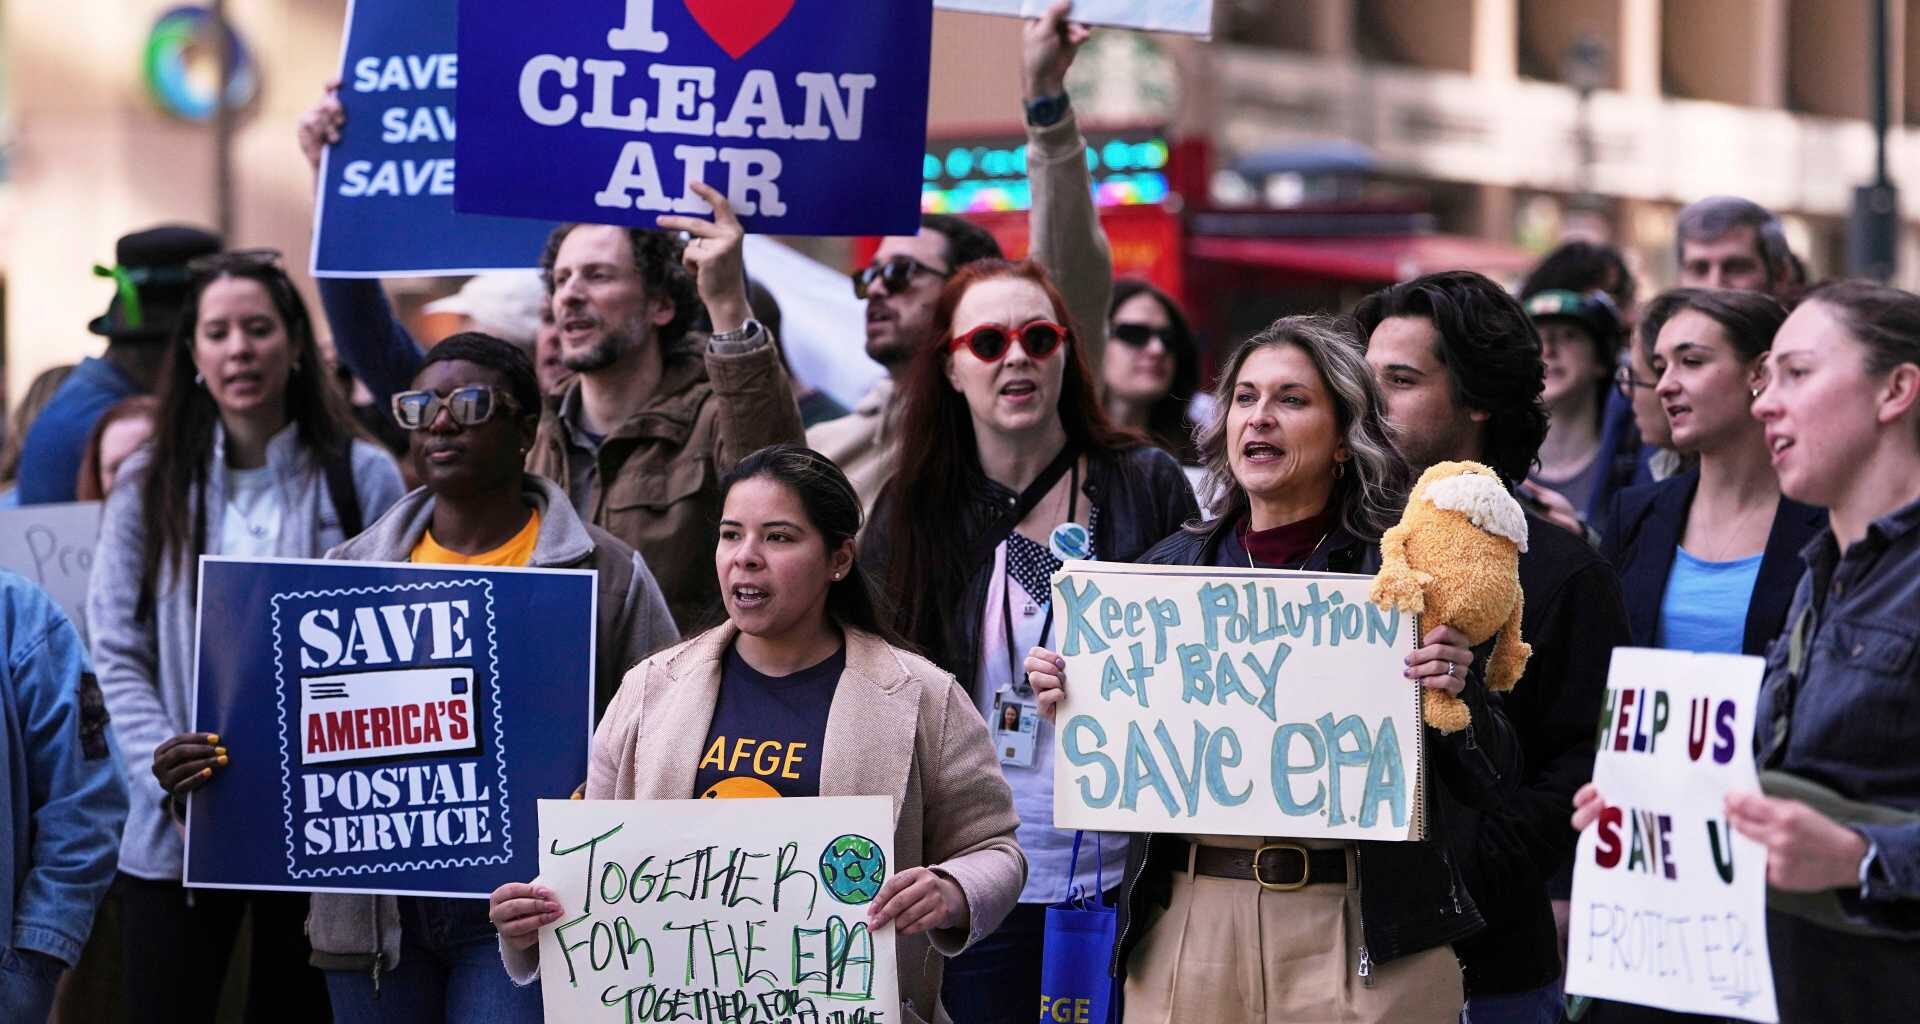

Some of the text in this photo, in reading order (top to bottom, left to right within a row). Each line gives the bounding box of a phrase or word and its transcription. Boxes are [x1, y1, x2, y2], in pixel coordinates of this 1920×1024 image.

[607, 0, 669, 53] I
[353, 54, 458, 92] SAVE
[519, 53, 877, 141] CLEAN
[338, 158, 456, 197] SAVE
[594, 141, 787, 217] AIR
[299, 600, 473, 669] SAVE
[1054, 575, 1181, 664] Keep
[1176, 641, 1292, 722] BAY
[307, 699, 470, 754] AMERICA'S
[698, 735, 807, 779] AFGE
[1597, 688, 1737, 765] HELP US
[301, 762, 490, 813] POSTAL
[304, 806, 492, 856] SERVICE
[1595, 806, 1733, 885] SAVE U
[550, 822, 818, 920] TOGETHER
[554, 912, 876, 1001] FOR THE EPA
[600, 983, 819, 1024] TOGETHER FOR
